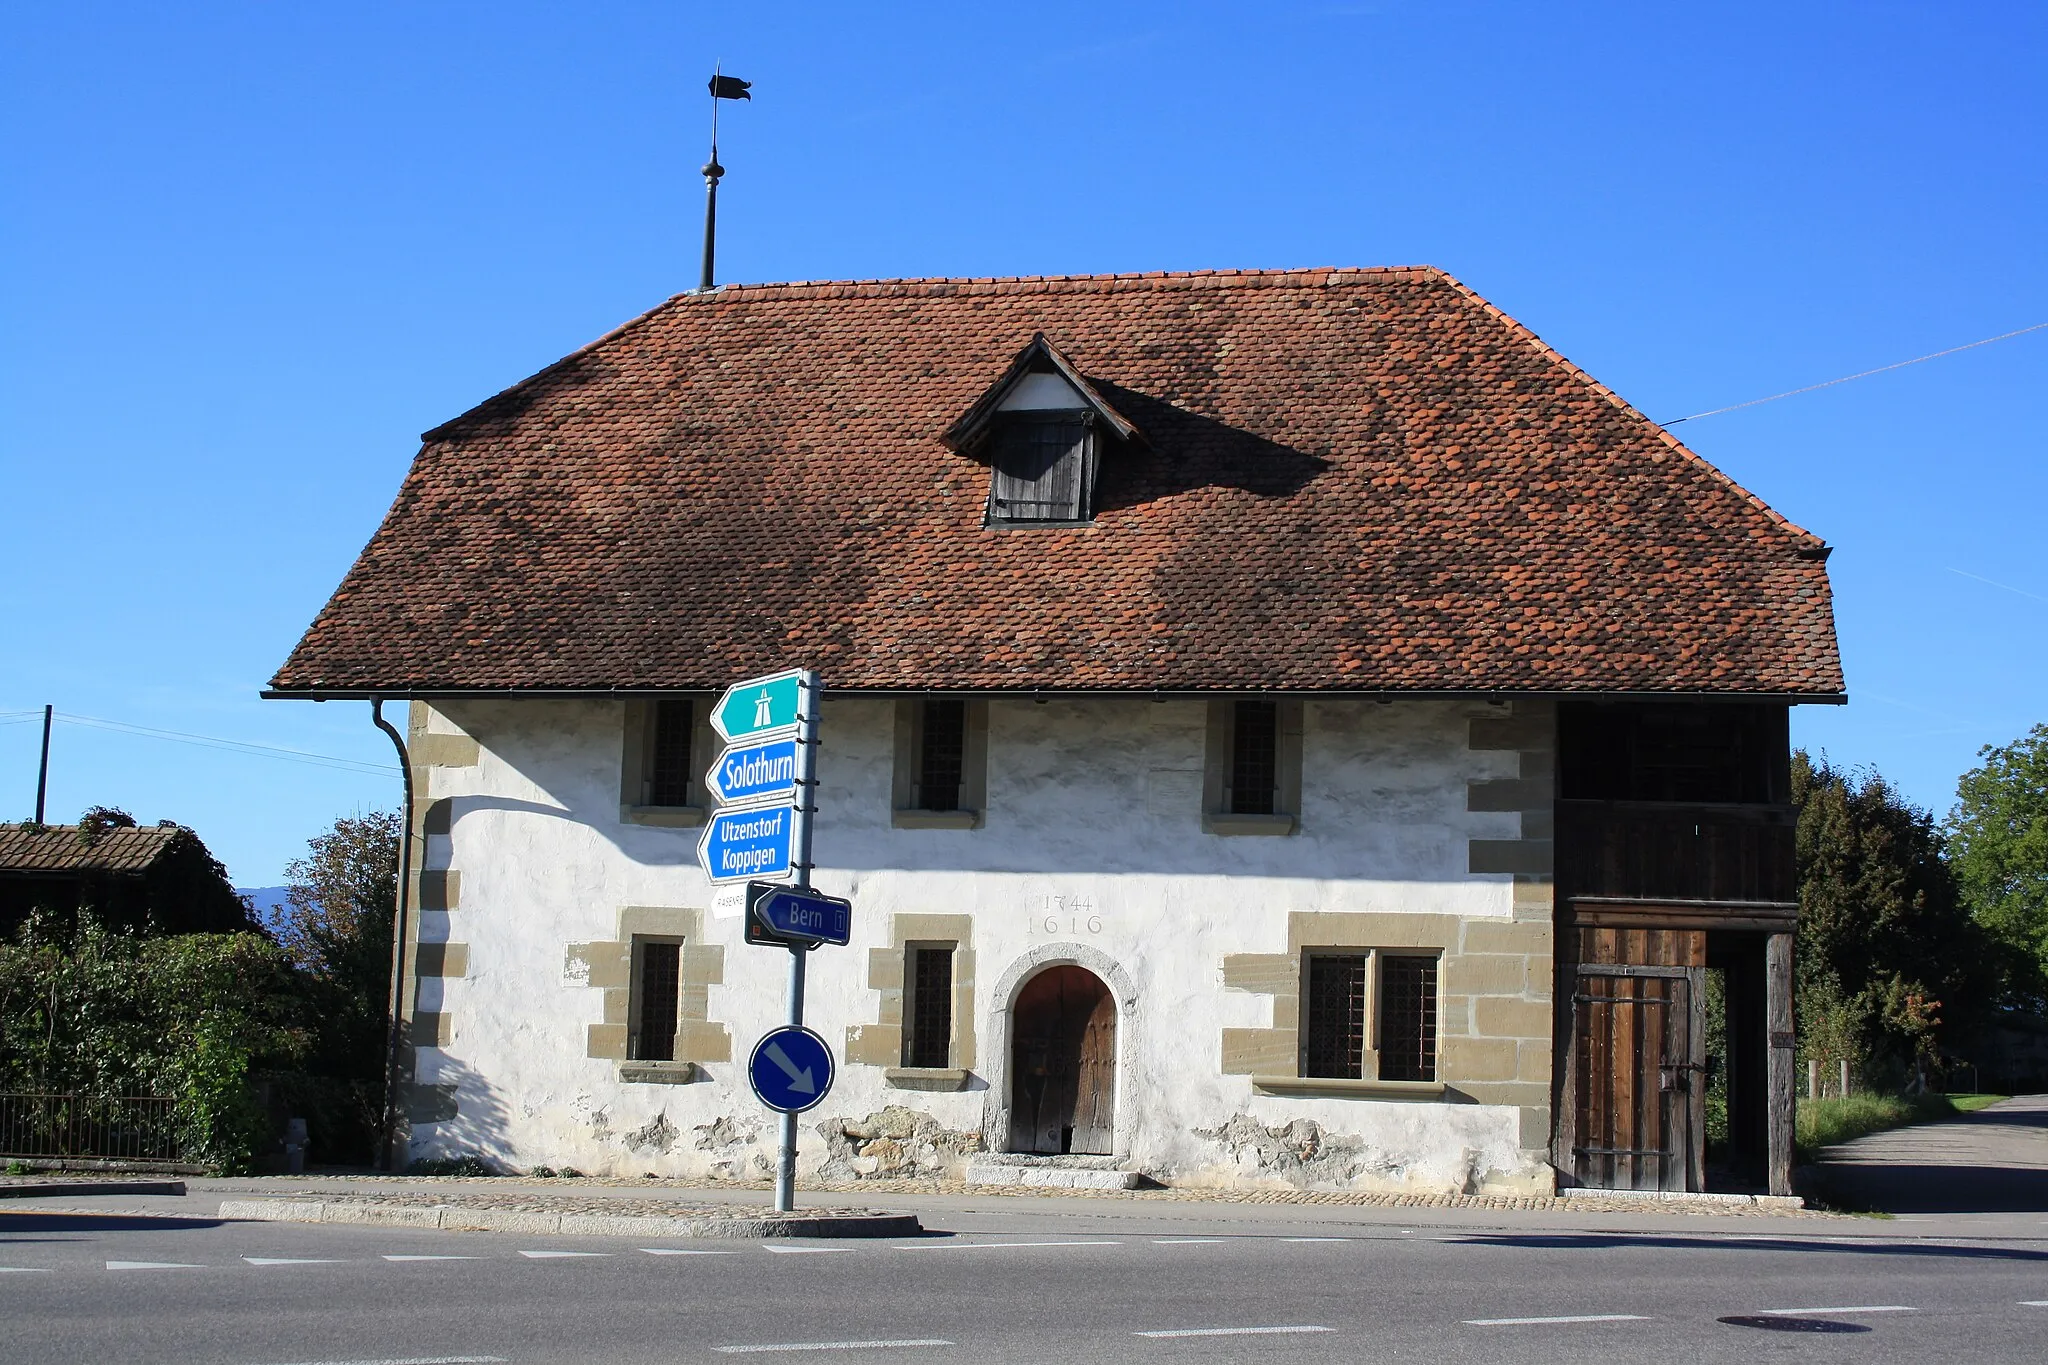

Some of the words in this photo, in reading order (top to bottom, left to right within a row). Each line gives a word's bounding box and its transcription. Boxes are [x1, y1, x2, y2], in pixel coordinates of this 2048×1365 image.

[725, 751, 793, 791] Solothurn
[721, 811, 783, 842] Utzenstorf
[722, 844, 775, 874] Koppigen
[717, 893, 745, 908] RASENRE
[1044, 895, 1092, 911] 1744
[790, 902, 822, 928] Bern
[1026, 915, 1102, 934] 1616
